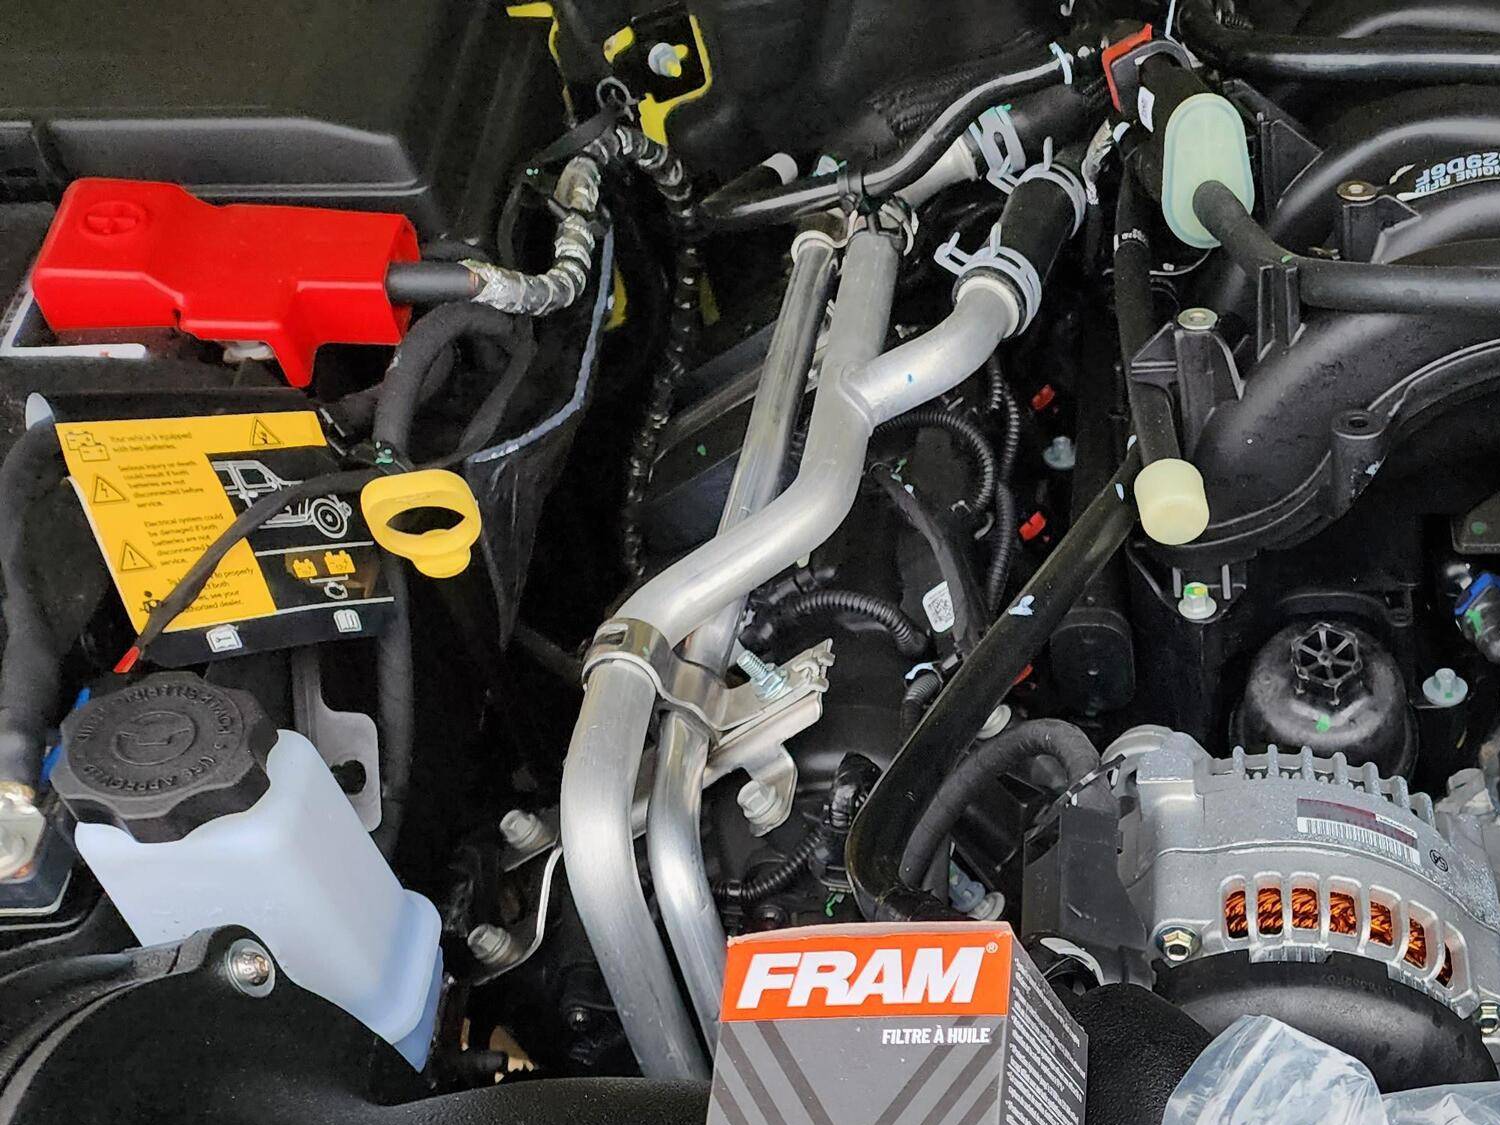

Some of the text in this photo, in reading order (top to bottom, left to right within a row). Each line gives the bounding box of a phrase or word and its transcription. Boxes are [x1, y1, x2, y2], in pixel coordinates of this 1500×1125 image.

[204, 512, 224, 521] could
[224, 566, 254, 578] properly
[882, 1024, 991, 1045] FILTRE À HUILE
